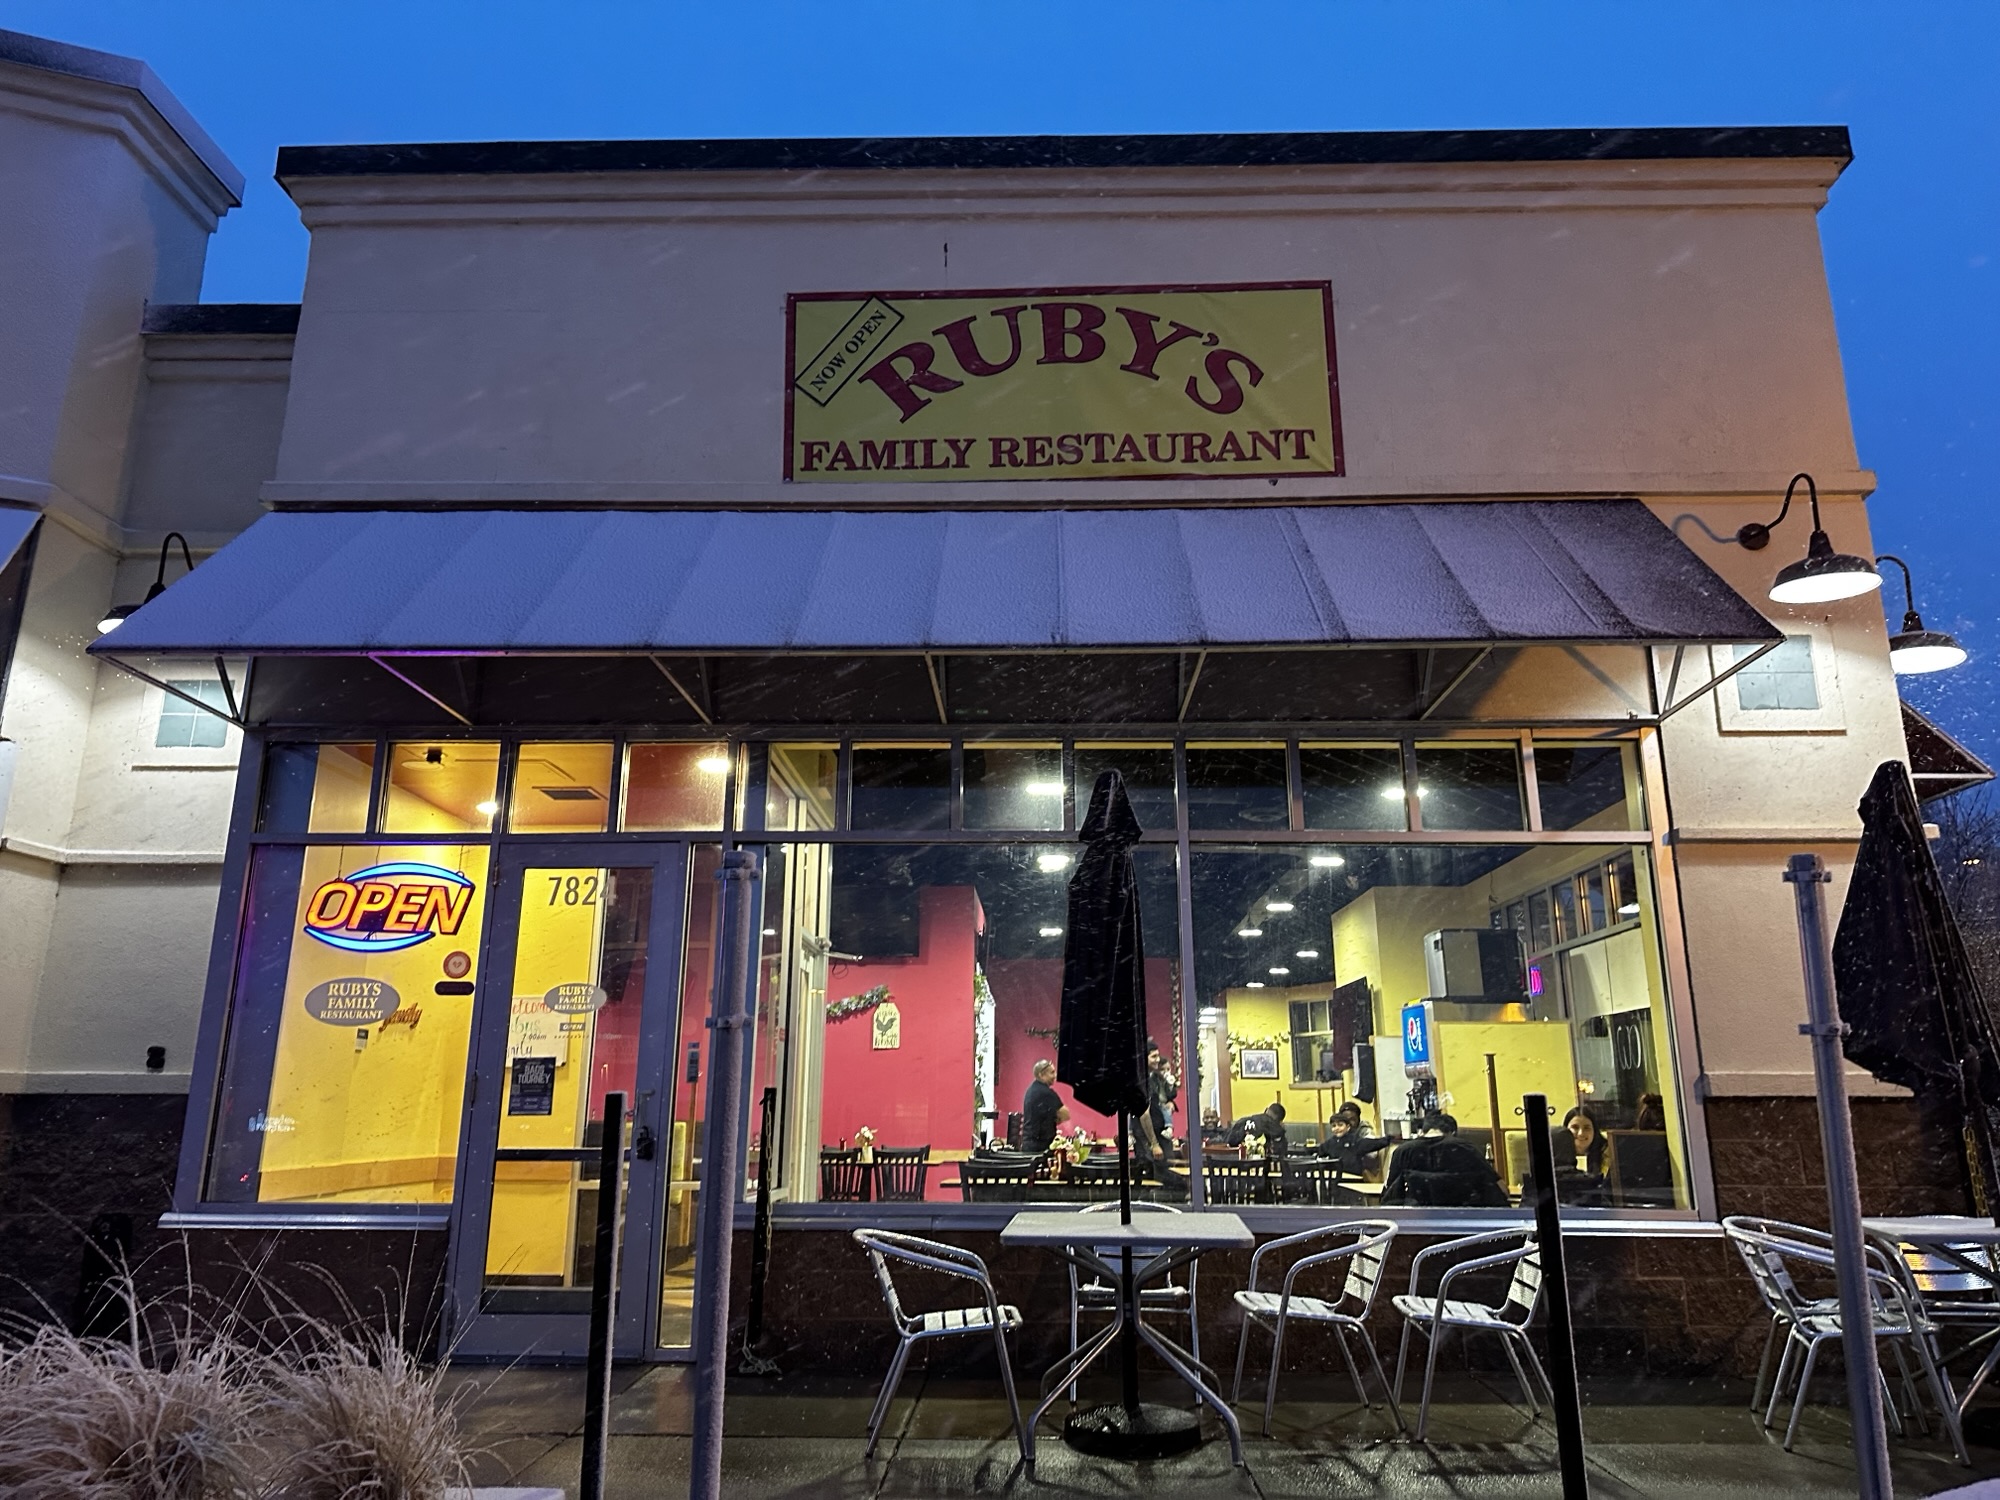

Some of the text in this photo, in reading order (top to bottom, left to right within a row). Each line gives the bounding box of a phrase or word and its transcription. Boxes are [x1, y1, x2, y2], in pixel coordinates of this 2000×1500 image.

[809, 309, 887, 392] NOW OPEN
[858, 302, 1264, 423] RUBY'S
[800, 429, 1315, 472] FAMILY RESTAURANT
[548, 875, 618, 906] 7824
[305, 879, 475, 936] OPEN
[327, 982, 382, 996] RUBY'S
[327, 997, 379, 1009] FAMILY
[558, 996, 592, 1004] FAMILY
[319, 1010, 383, 1019] RESTAURANT
